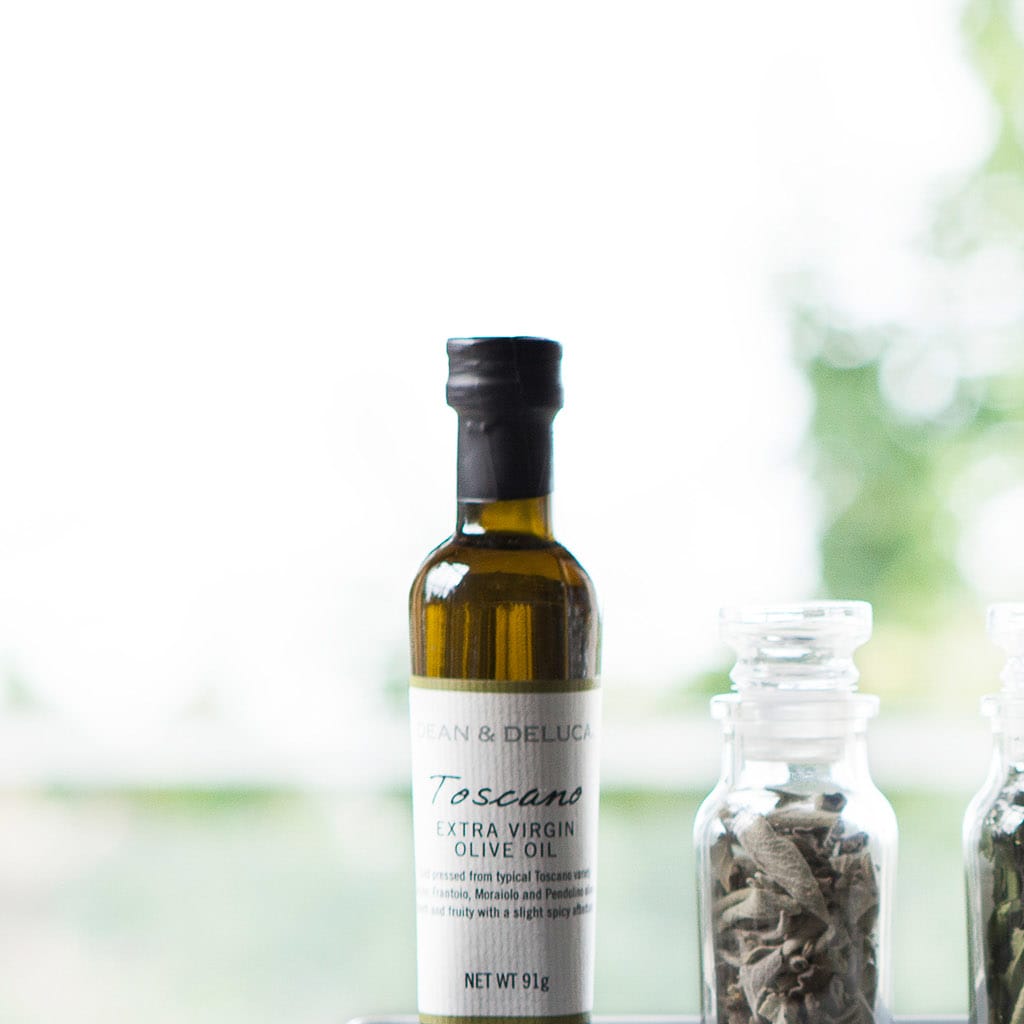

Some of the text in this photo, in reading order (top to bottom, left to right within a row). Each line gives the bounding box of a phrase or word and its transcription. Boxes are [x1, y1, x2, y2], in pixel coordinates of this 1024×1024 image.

[478, 725, 495, 742] &
[504, 723, 592, 743] DELUCA
[430, 774, 582, 807] Toscano
[436, 821, 575, 838] EXTRA VIRGIN
[455, 841, 558, 859] OLIVE OIL
[469, 869, 493, 882] from
[496, 870, 531, 884] typical
[475, 888, 519, 901] Moraiolo
[522, 888, 542, 901] and
[449, 906, 475, 920] fruity
[477, 906, 500, 919] with
[503, 908, 510, 919] a
[513, 906, 543, 921] slight
[546, 905, 571, 920] spicy
[464, 972, 550, 993] NET WT 91g
